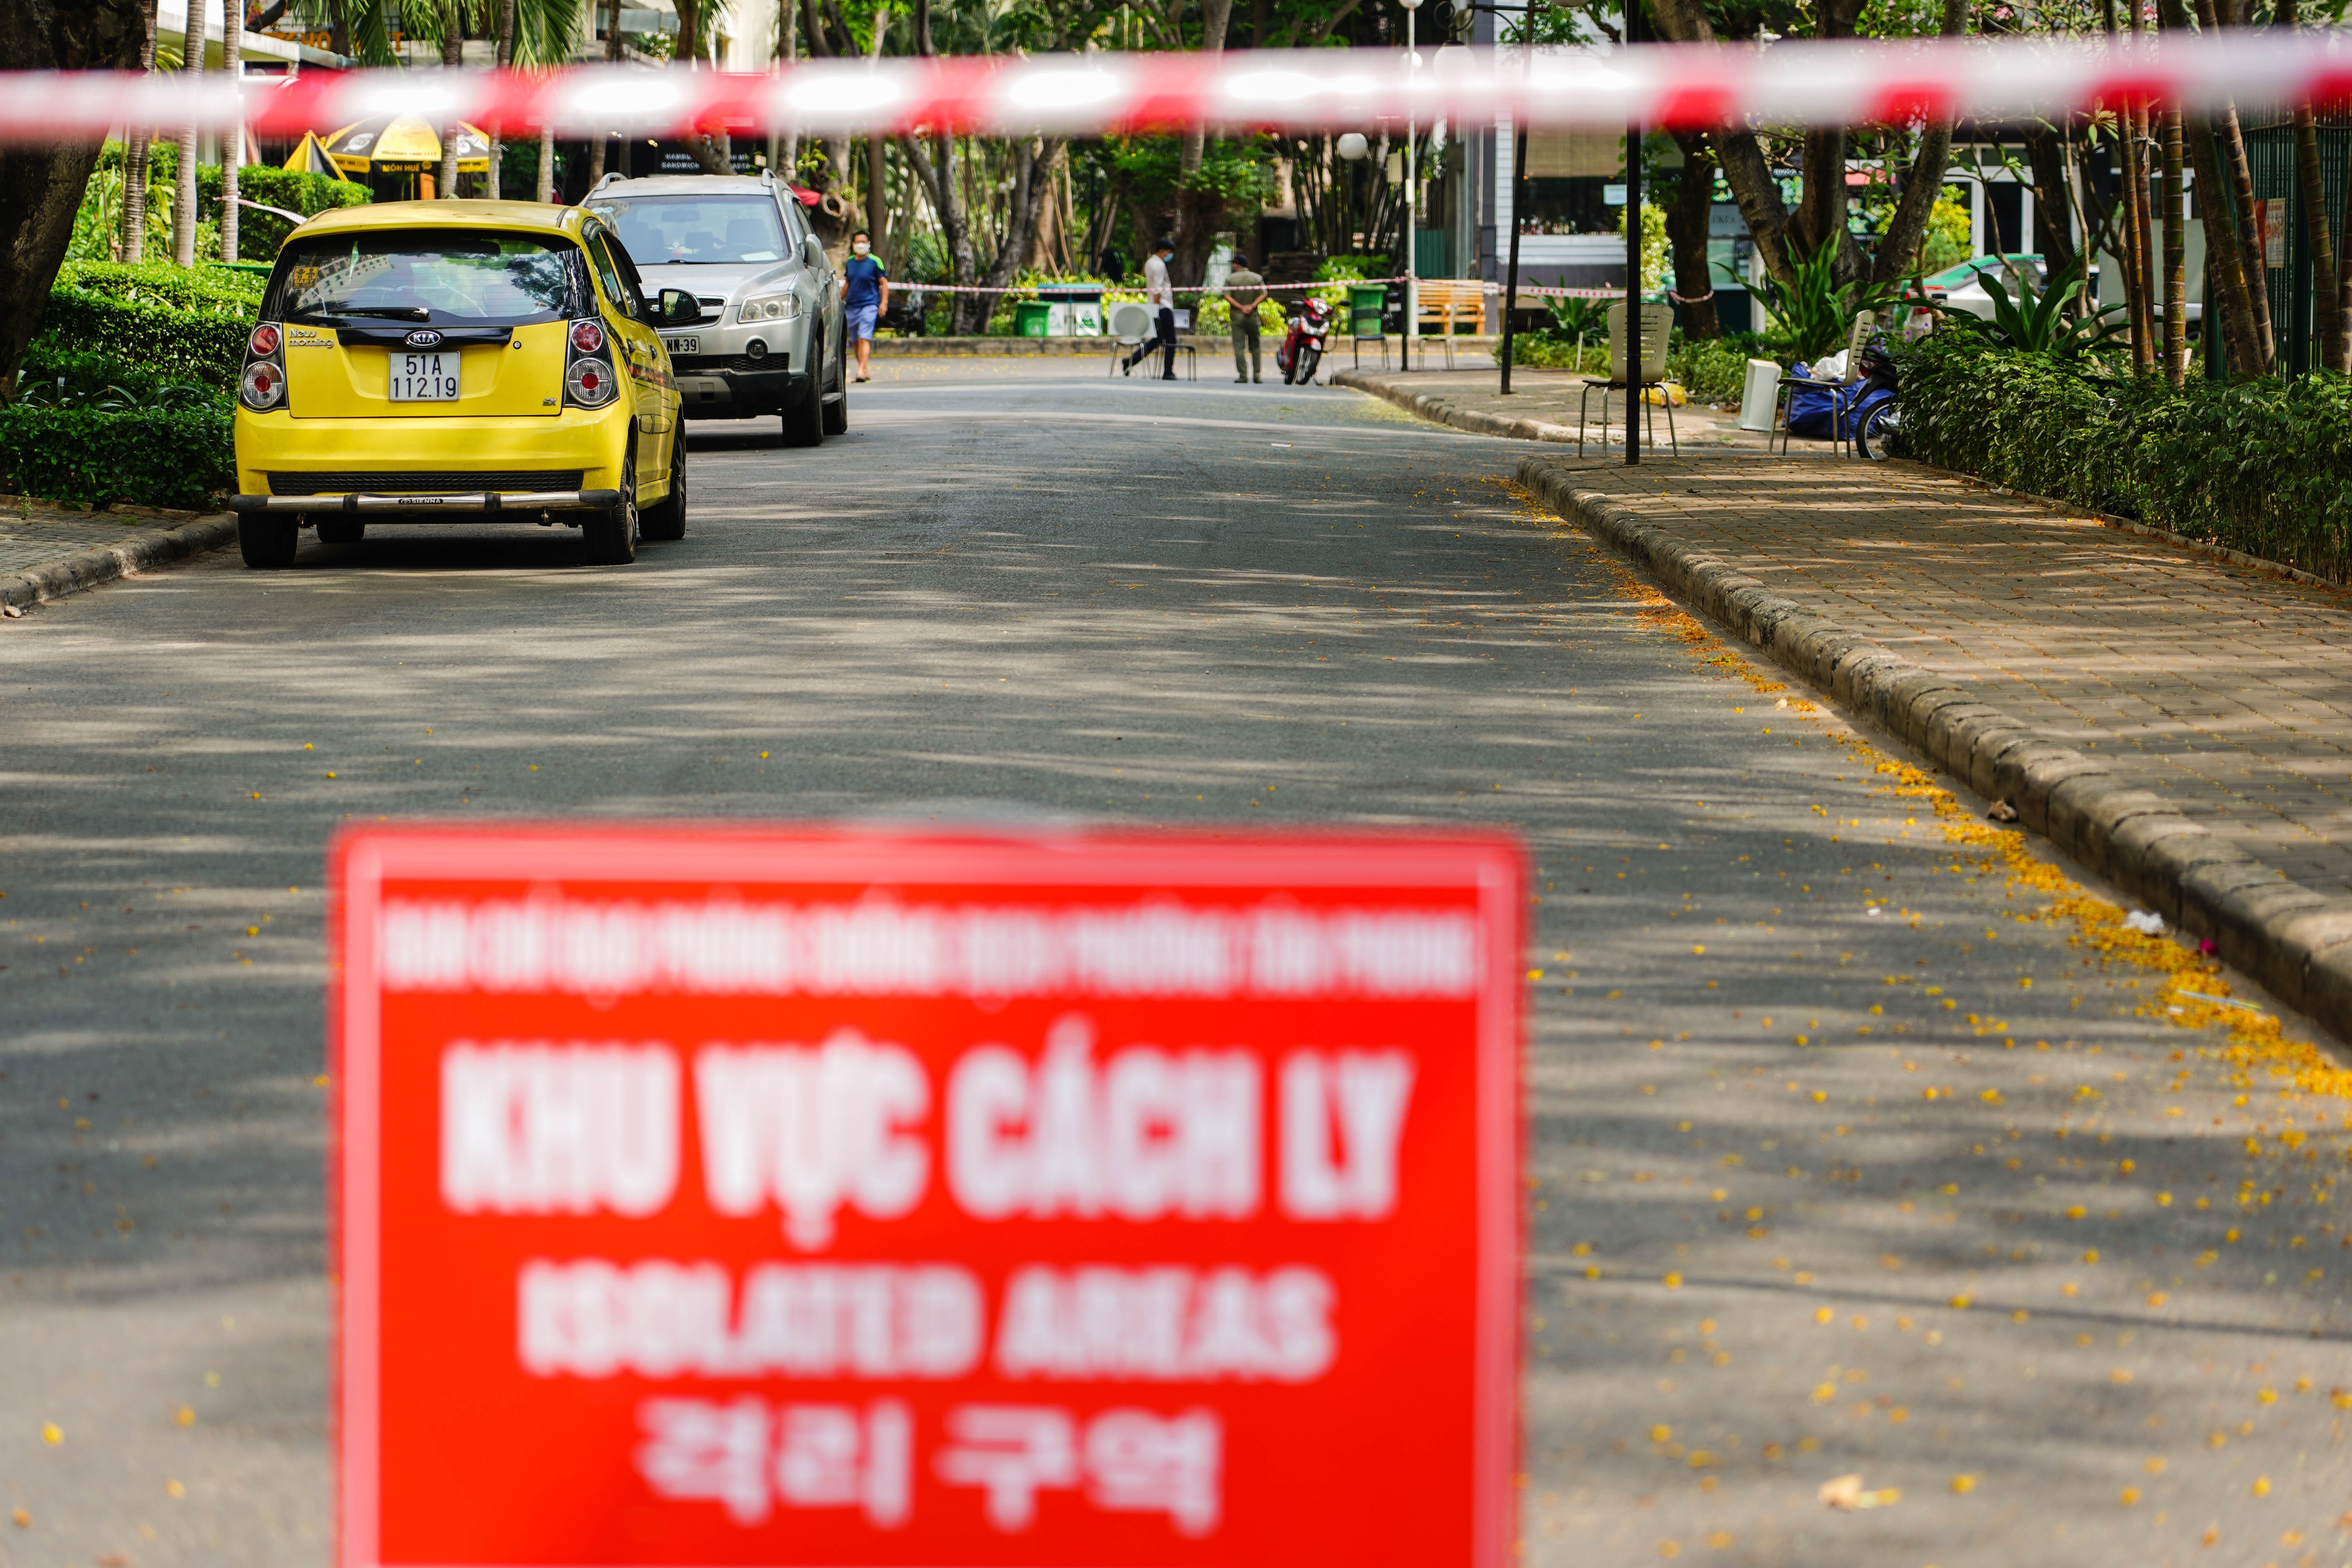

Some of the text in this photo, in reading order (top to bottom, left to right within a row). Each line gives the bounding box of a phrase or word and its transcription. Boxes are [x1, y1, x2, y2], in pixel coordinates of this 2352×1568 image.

[382, 163, 403, 172] MÓN
[289, 327, 316, 338] New
[413, 334, 435, 343] KIA
[289, 338, 334, 348] morning
[406, 355, 442, 375] 51A
[394, 377, 456, 397] 112.19
[543, 398, 557, 406] SX
[438, 1016, 1416, 1252] KHU VỰC CÁCH LY
[516, 1258, 1336, 1381] ISOLATED AREAS
[638, 1396, 1222, 1534] 격리 구역
